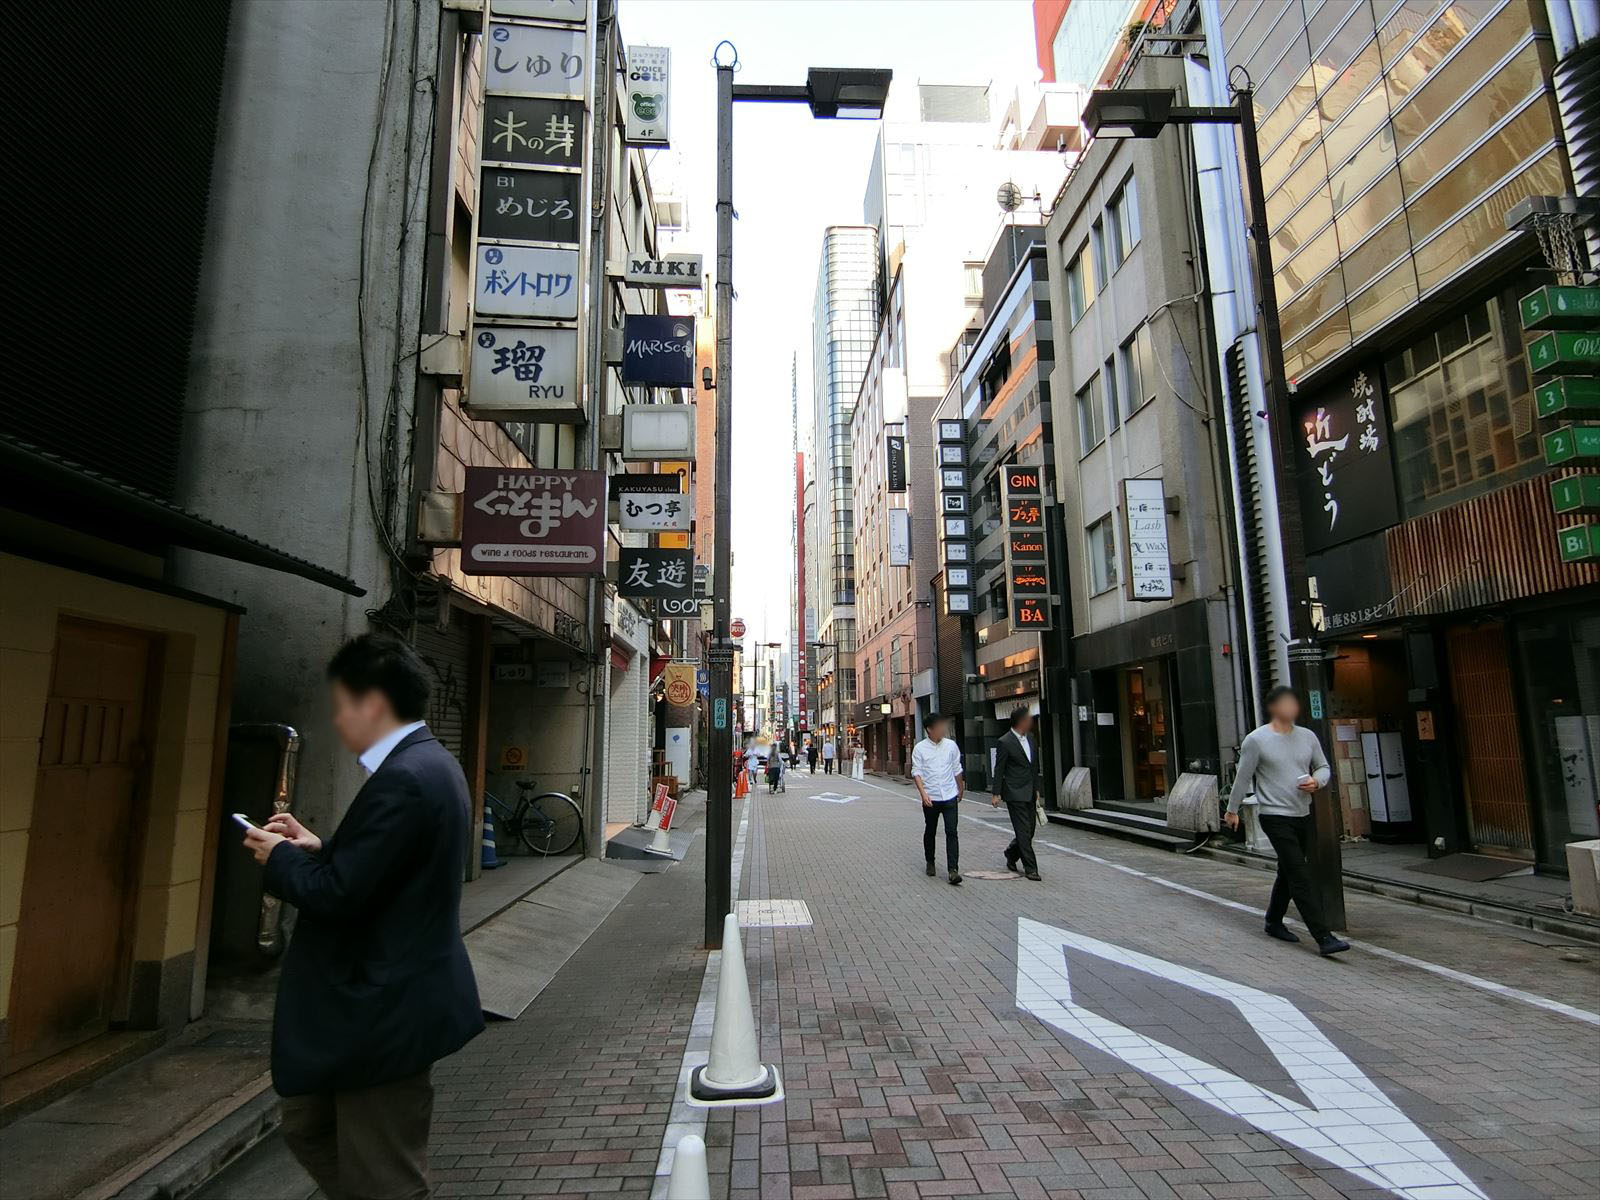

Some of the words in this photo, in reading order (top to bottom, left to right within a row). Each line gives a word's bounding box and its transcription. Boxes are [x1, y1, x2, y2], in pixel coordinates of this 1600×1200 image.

[494, 46, 583, 79] しゅり
[630, 73, 666, 81] GOLF
[492, 111, 575, 157] 木の芽
[496, 176, 514, 187] B1
[496, 197, 574, 219] めじろ
[630, 260, 698, 276] MIKI
[1530, 300, 1539, 316] 5
[1538, 345, 1548, 359] 4
[492, 340, 546, 383] 瑠
[529, 385, 564, 399] RYU
[1545, 391, 1555, 407] 3
[1553, 438, 1564, 454] 2
[497, 475, 577, 491] HAPPY
[1010, 475, 1037, 488] GIN
[626, 500, 681, 518] むつ亭
[1012, 542, 1043, 551] Kanon
[1566, 536, 1583, 553] B1
[625, 558, 687, 588] 友遊
